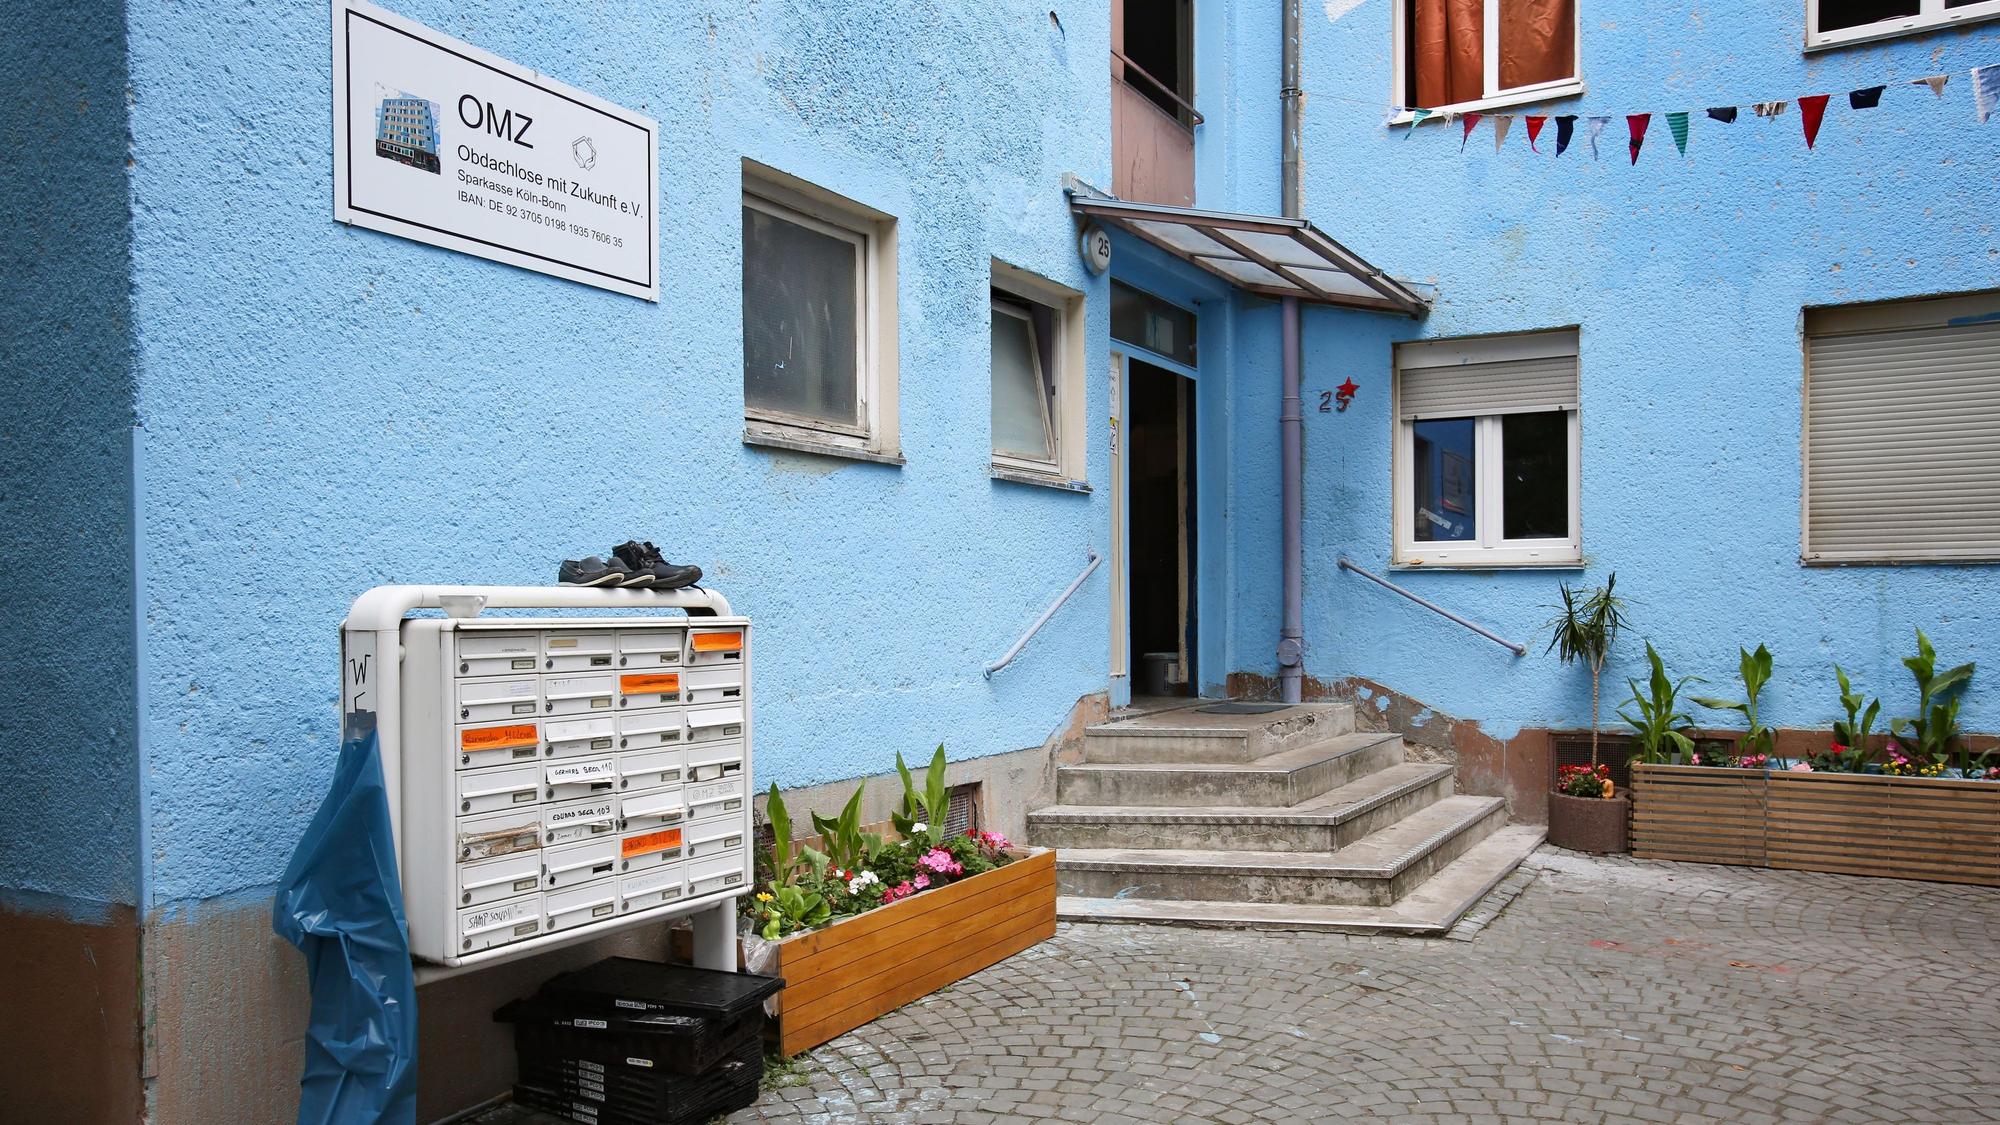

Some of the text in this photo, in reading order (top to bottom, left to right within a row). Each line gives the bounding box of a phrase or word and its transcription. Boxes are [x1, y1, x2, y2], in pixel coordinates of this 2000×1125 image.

[457, 93, 534, 149] OMZ
[457, 144, 644, 219] Obdachlose mit Zukunft e.V.
[457, 168, 567, 213] Sparkasse Köln-Bonn
[457, 189, 624, 248] IBAN: DE 92 3705 0198 1935 7606 35
[1097, 236, 1109, 258] 25
